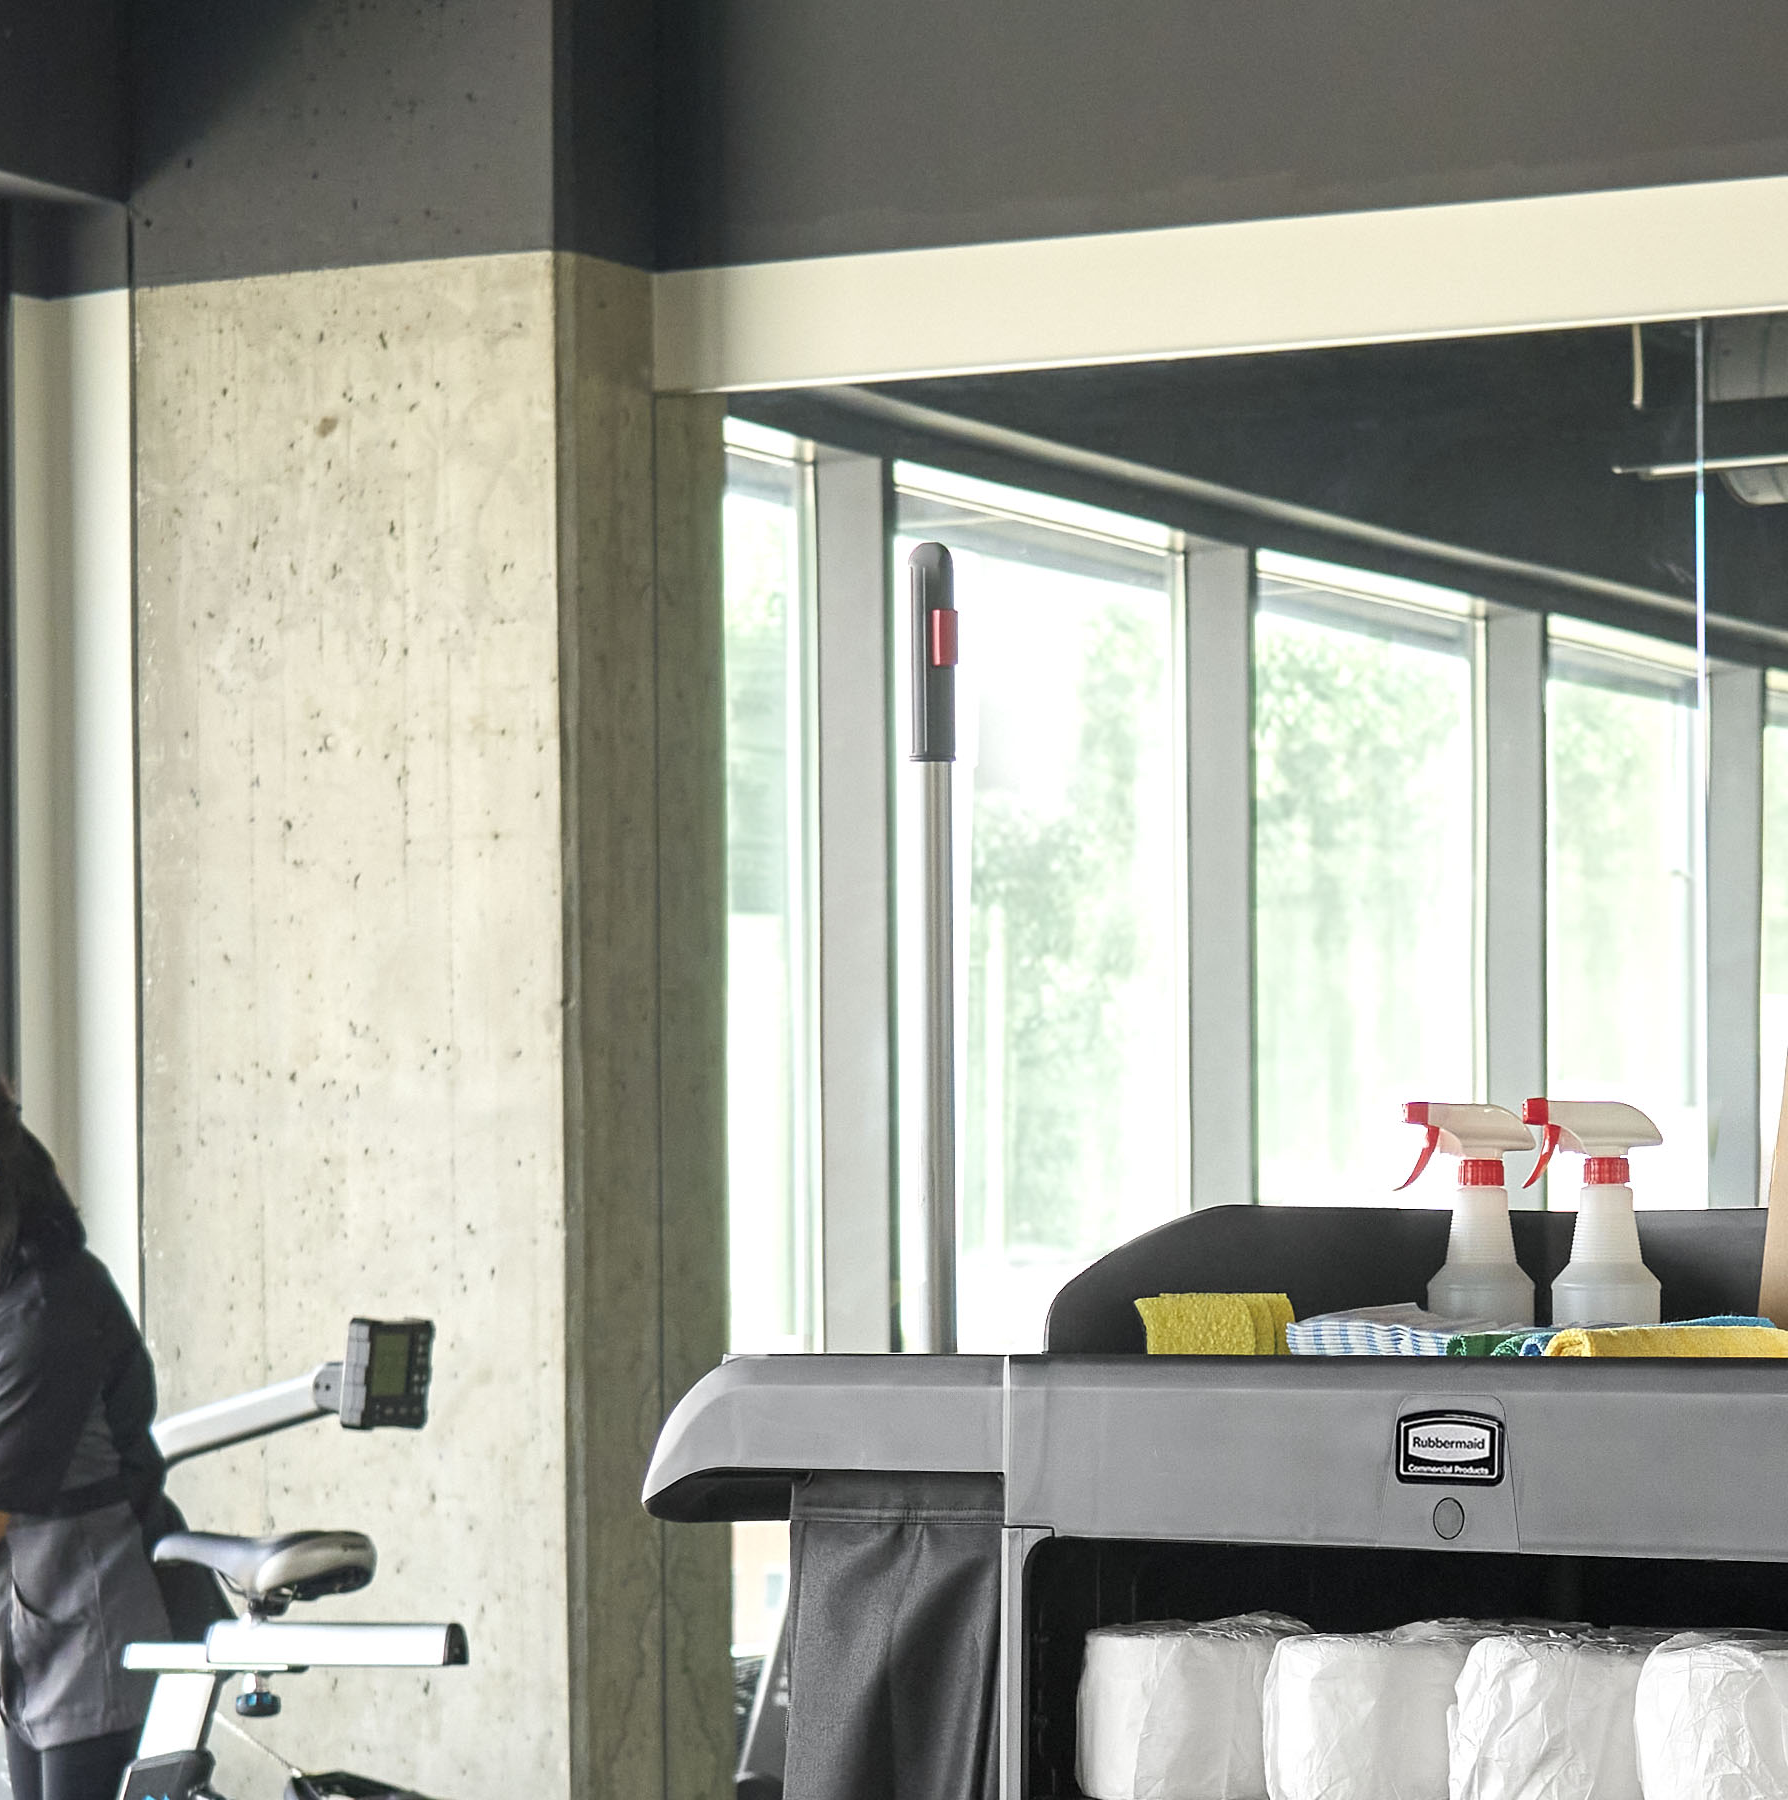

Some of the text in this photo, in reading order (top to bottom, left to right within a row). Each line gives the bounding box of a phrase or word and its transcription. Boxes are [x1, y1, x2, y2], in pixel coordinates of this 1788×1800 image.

[1412, 1436, 1486, 1451] Rubbermaid
[1407, 1463, 1490, 1476] Commercial Products
